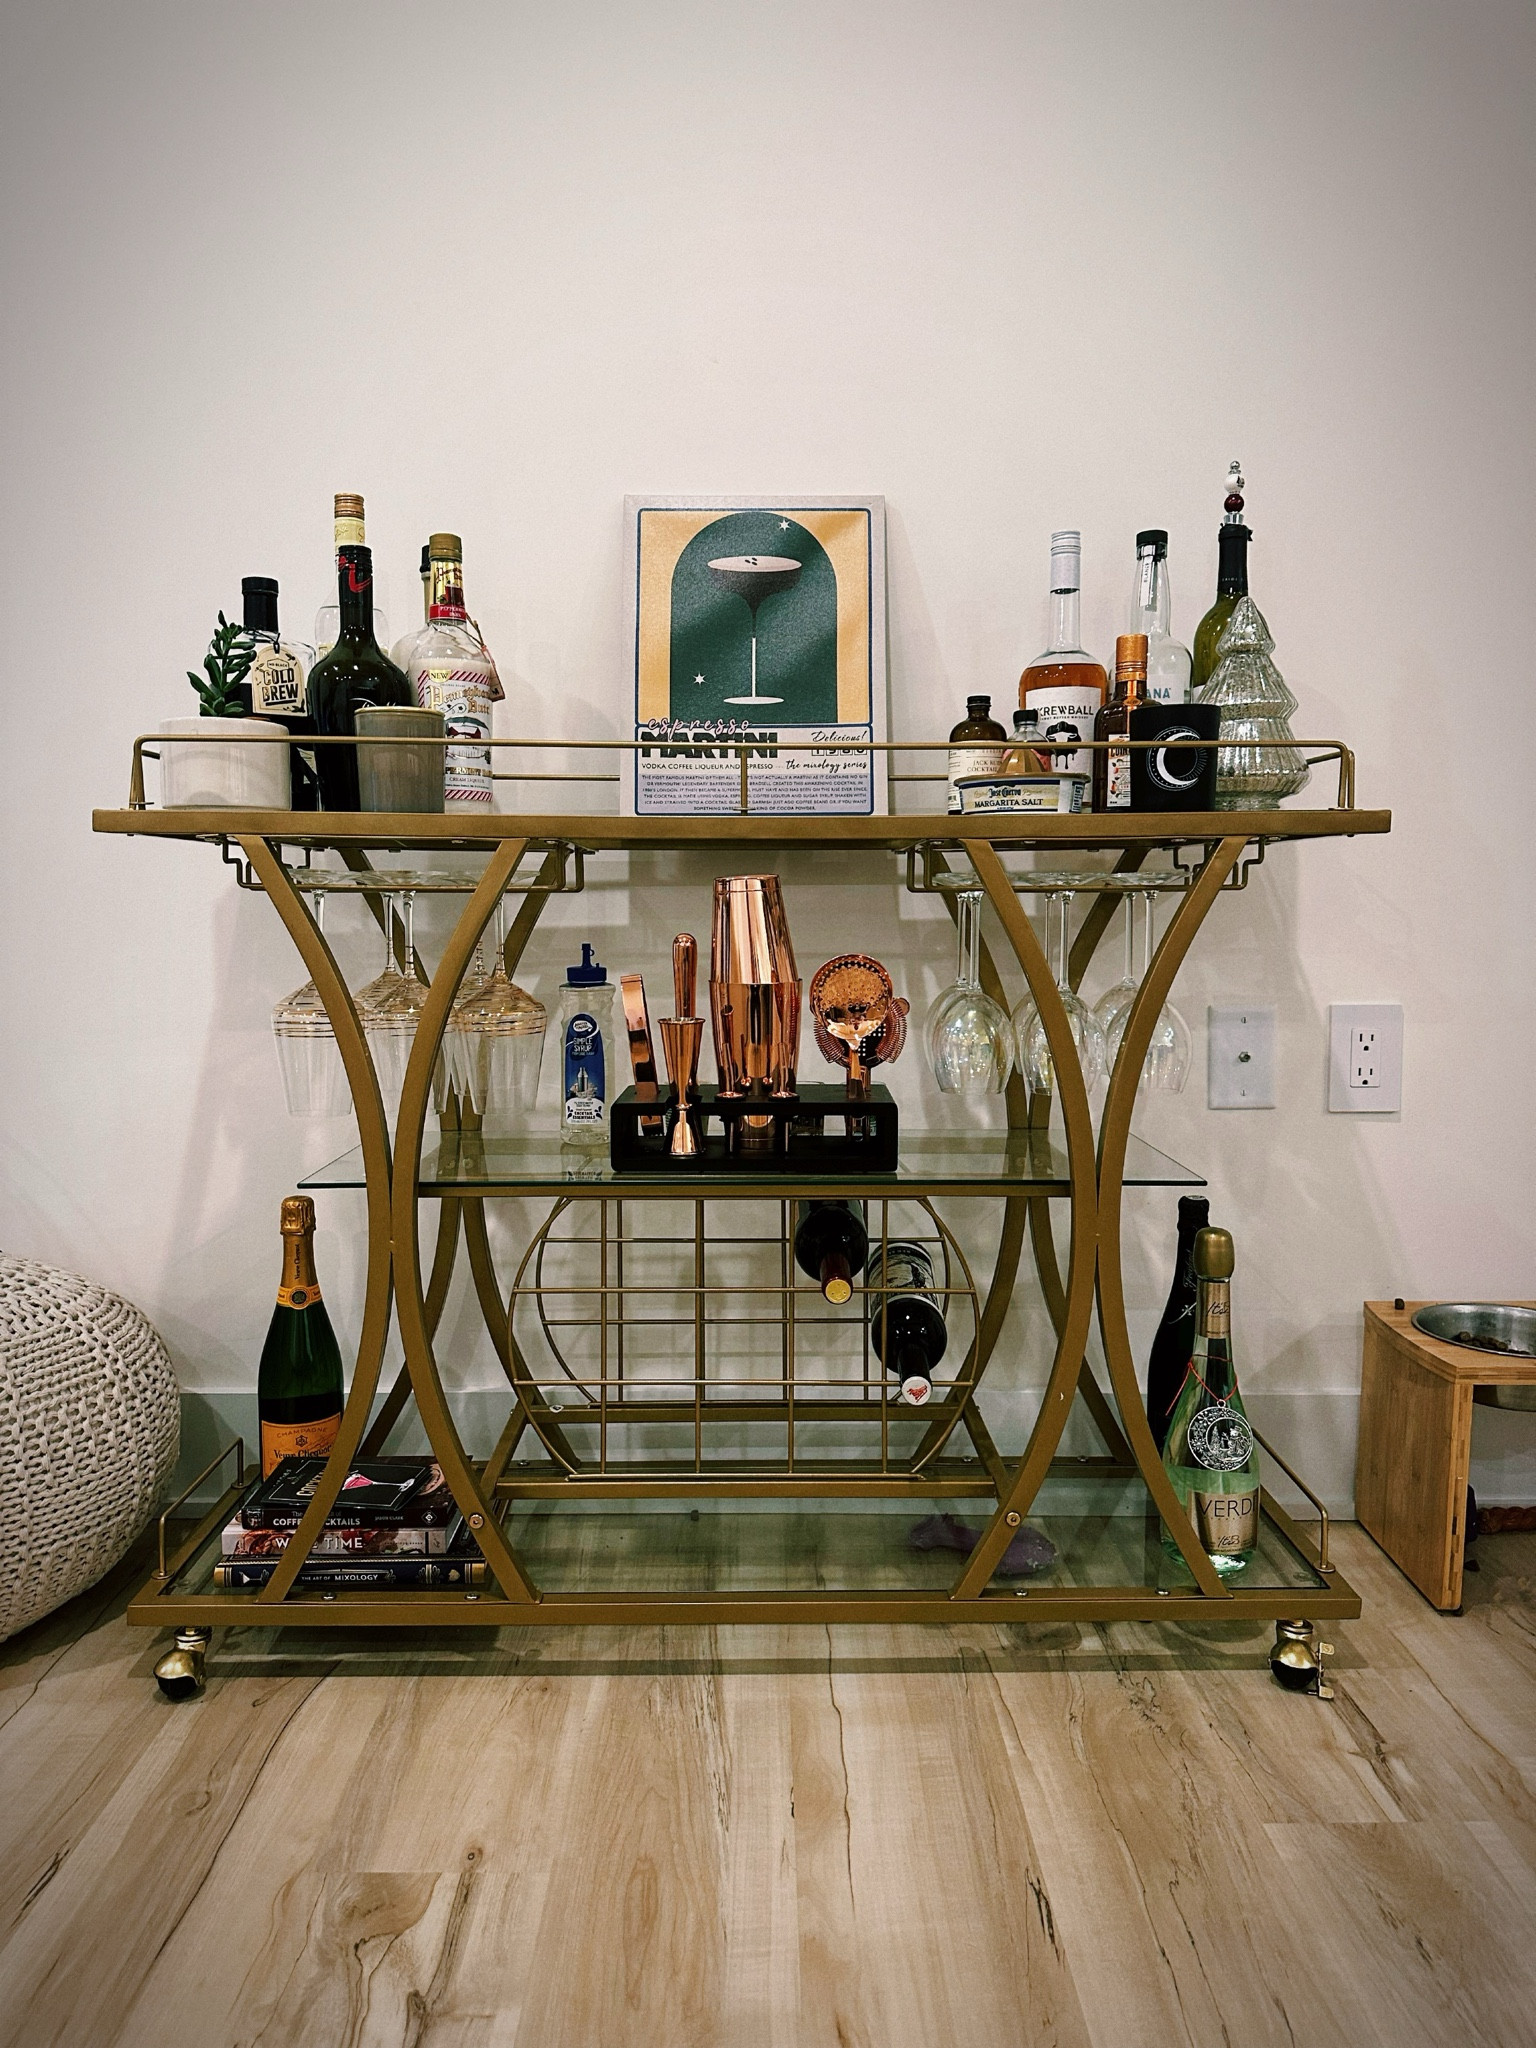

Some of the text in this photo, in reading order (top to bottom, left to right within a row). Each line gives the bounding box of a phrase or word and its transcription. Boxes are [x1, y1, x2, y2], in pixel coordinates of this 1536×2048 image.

[263, 668, 295, 686] COLD
[430, 672, 449, 680] NEW
[262, 683, 299, 702] BREW
[1033, 705, 1094, 716] KREWBALL
[648, 717, 752, 742] espresso
[811, 730, 867, 742] Delicious!
[641, 731, 777, 758] MARTINI
[786, 759, 867, 773] the mixology series
[975, 800, 1020, 808] MARGARITA
[573, 1037, 593, 1045] SIMPLE
[277, 1427, 328, 1438] CHAMPAGNE
[325, 1537, 363, 1549] TIME
